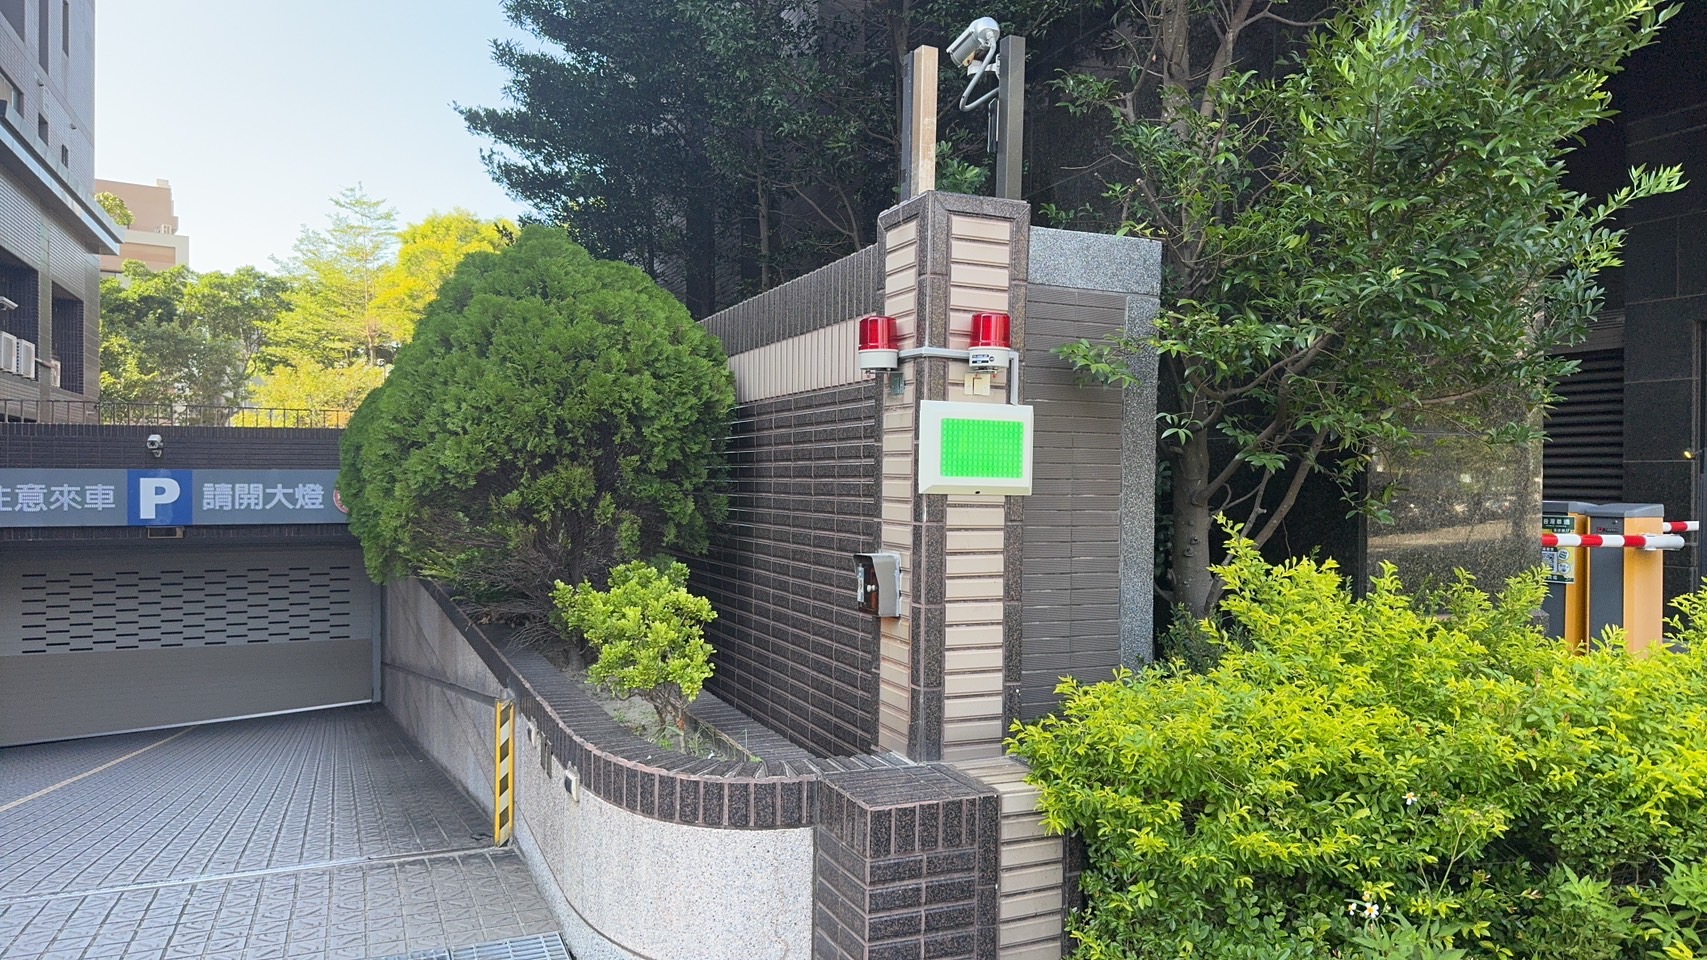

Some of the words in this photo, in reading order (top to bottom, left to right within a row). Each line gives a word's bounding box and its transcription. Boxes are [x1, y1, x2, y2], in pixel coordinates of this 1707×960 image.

[140, 477, 181, 519] P
[202, 483, 325, 511] 請開大燈
